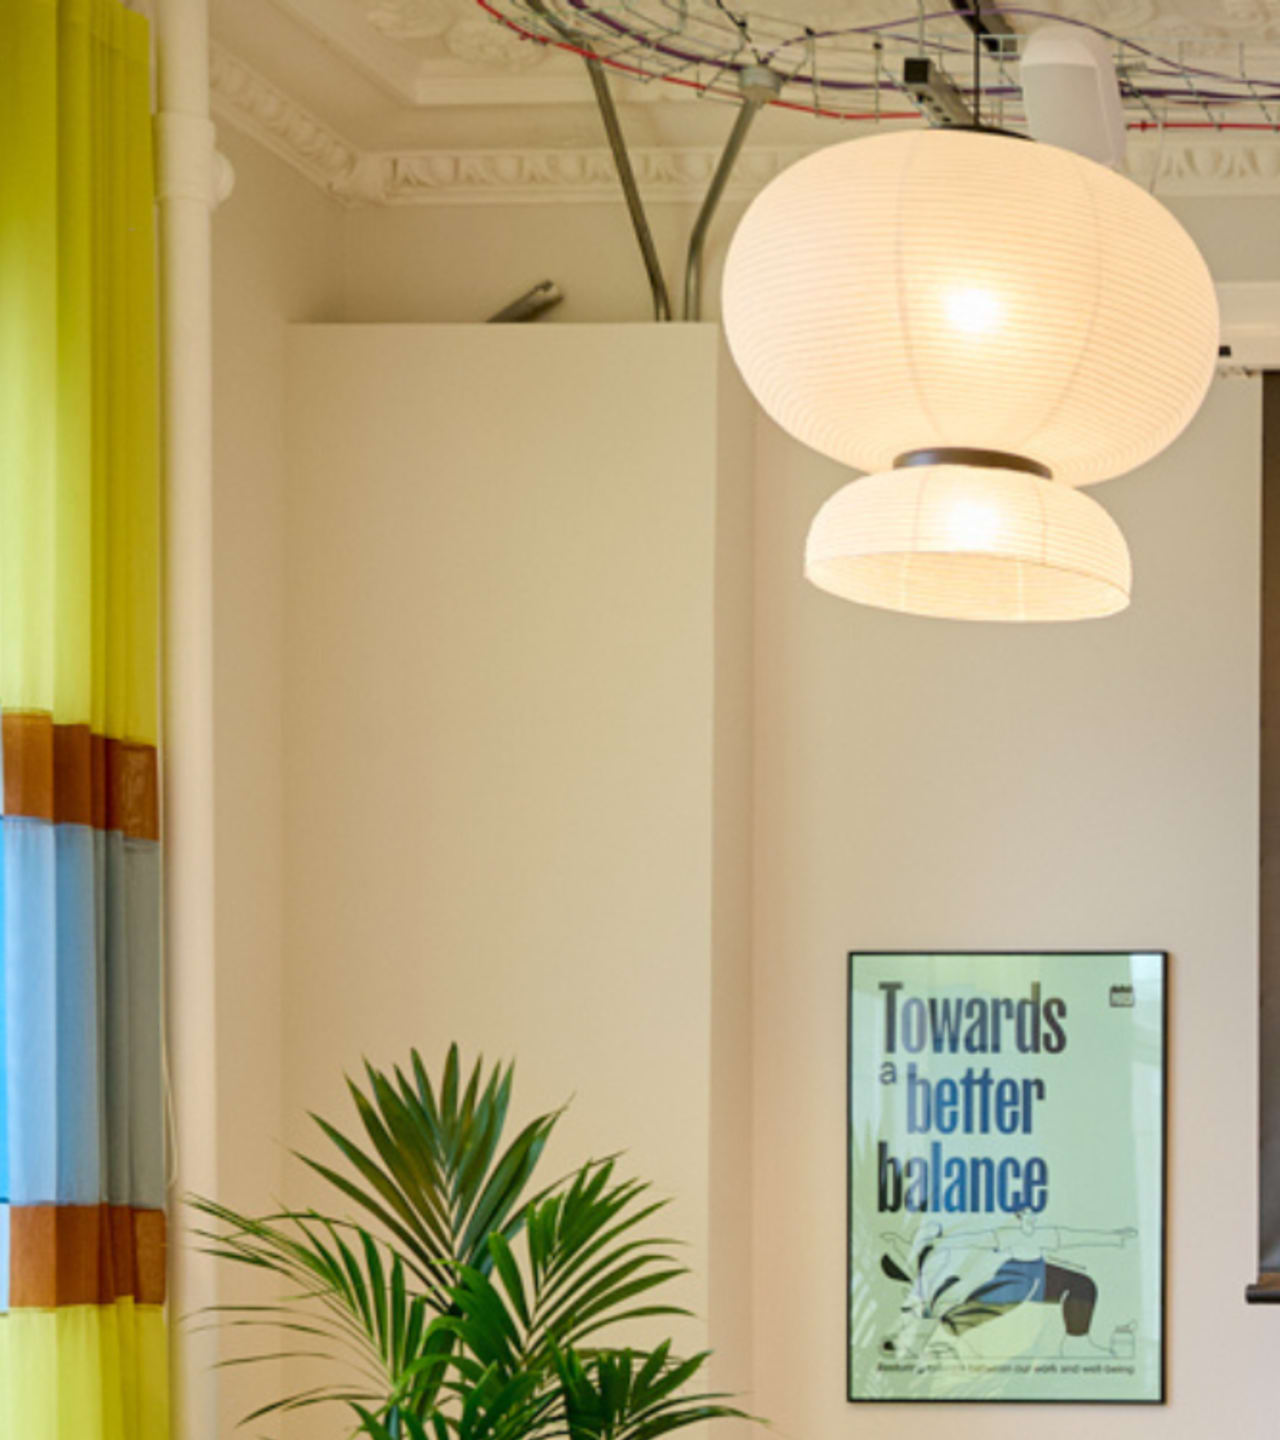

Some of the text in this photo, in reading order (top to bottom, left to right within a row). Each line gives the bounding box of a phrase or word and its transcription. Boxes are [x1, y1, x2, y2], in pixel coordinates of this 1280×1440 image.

[878, 981, 1067, 1055] Towards
[880, 1061, 1046, 1135] a better
[877, 1141, 1048, 1214] balance
